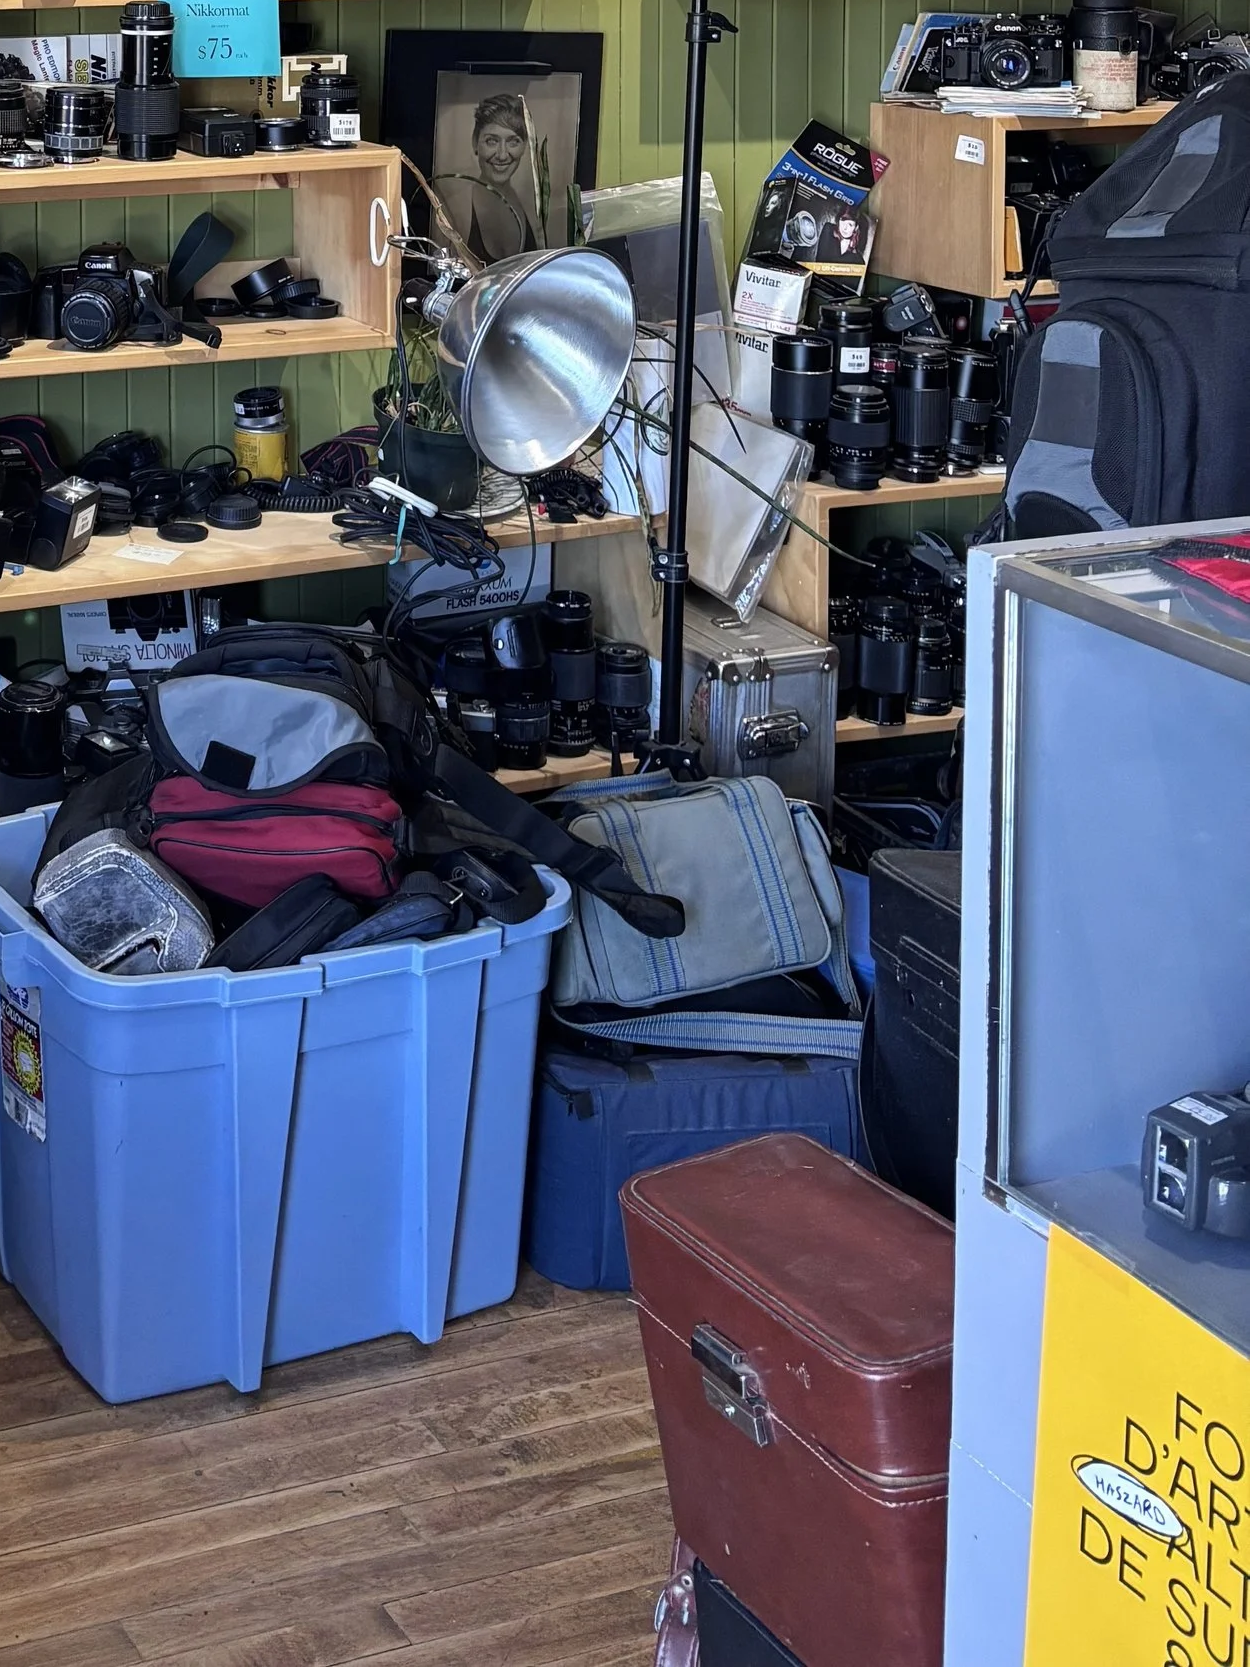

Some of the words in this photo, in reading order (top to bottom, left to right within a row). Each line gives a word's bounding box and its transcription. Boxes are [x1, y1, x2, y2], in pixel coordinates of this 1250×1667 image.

[186, 3, 250, 17] Nikkormat
[31, 39, 43, 63] Magic
[42, 39, 51, 55] PRO
[198, 37, 233, 60] $75
[807, 176, 834, 195] FLASH
[833, 190, 855, 206] GRID
[85, 261, 112, 269] Canon
[745, 270, 781, 288] Vivitar
[742, 291, 753, 300] 2X
[70, 316, 101, 327] Canon
[446, 596, 476, 611] FLASH
[480, 589, 520, 606] 5400HS
[134, 643, 191, 660] MINOLTA
[1124, 1416, 1250, 1551] D'AR
[1095, 1474, 1166, 1526] HASZARD
[1079, 1505, 1147, 1602] DE
